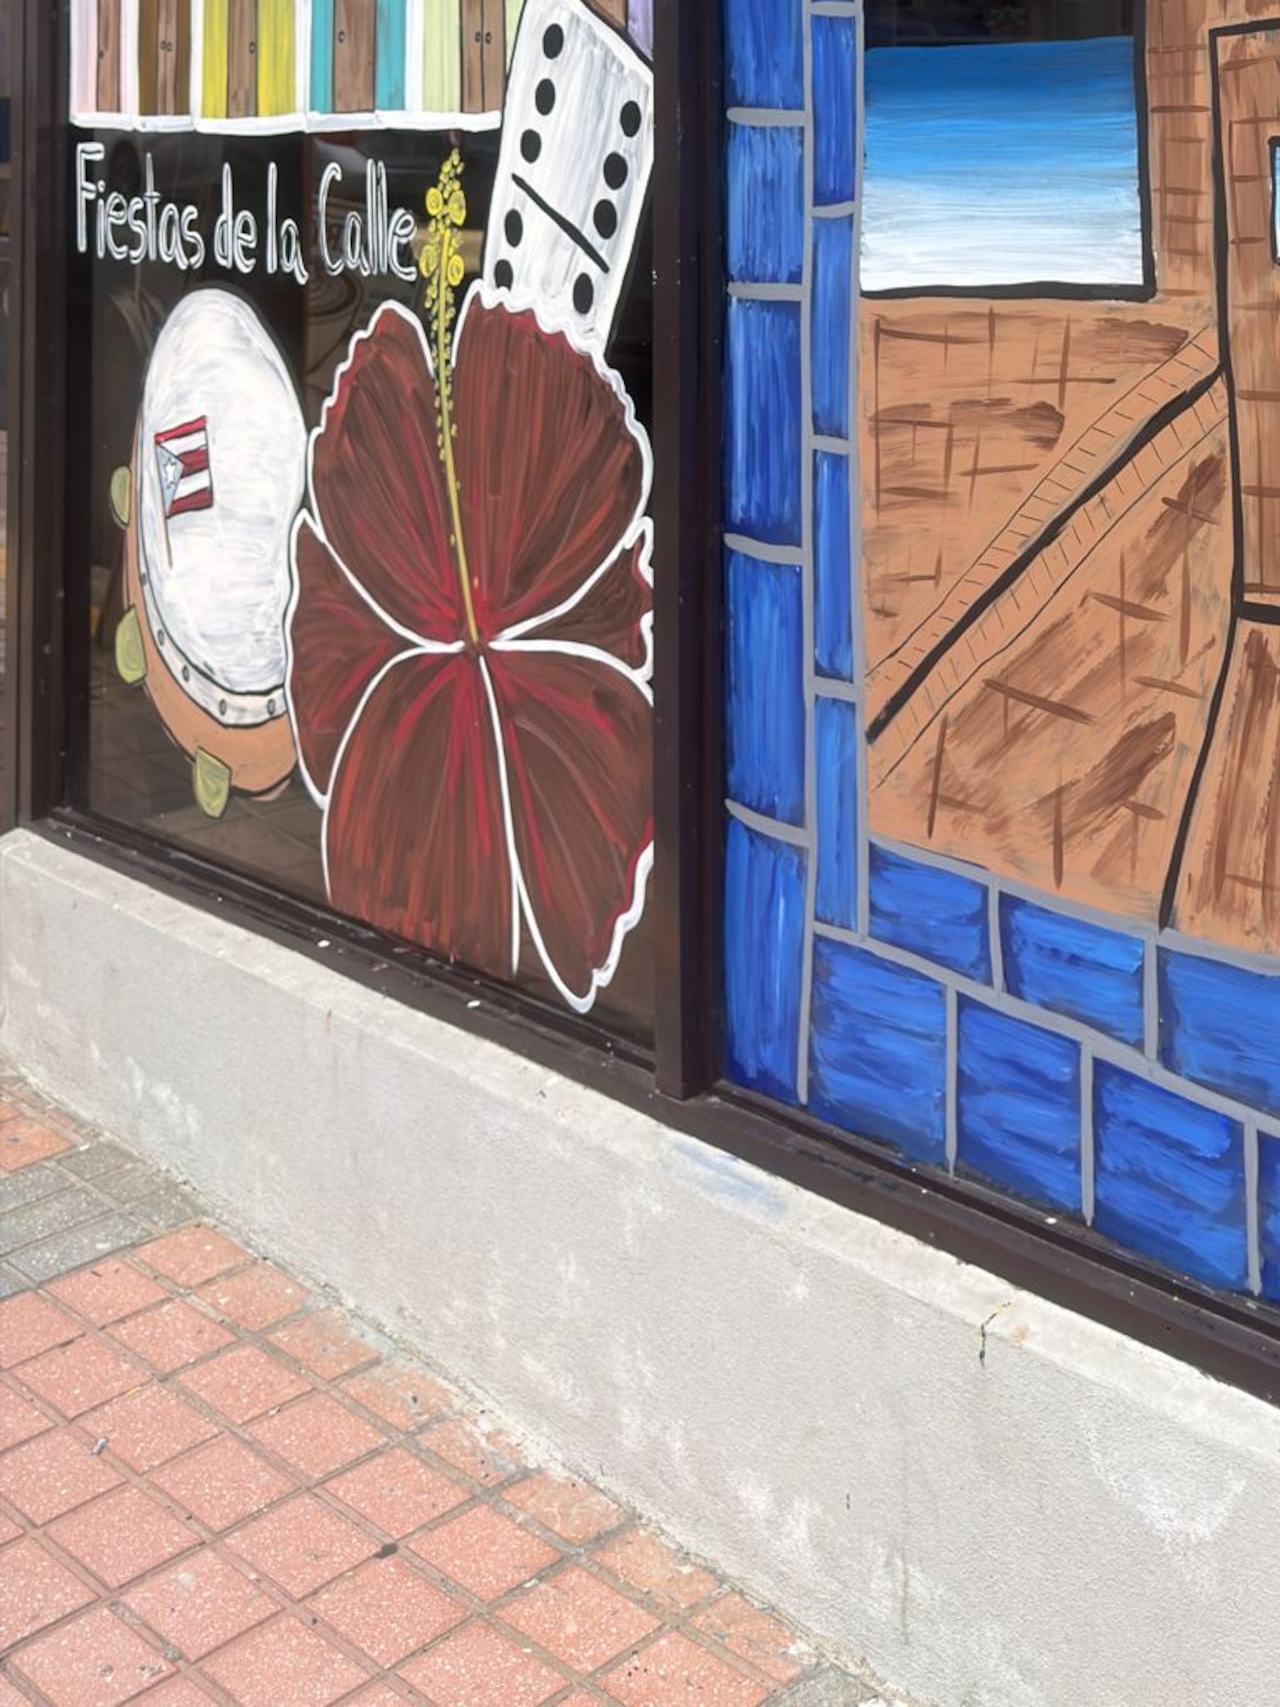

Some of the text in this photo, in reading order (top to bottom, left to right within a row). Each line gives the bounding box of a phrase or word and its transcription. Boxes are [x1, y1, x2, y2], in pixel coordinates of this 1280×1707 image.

[76, 142, 417, 285] Fiestas de la Calle
